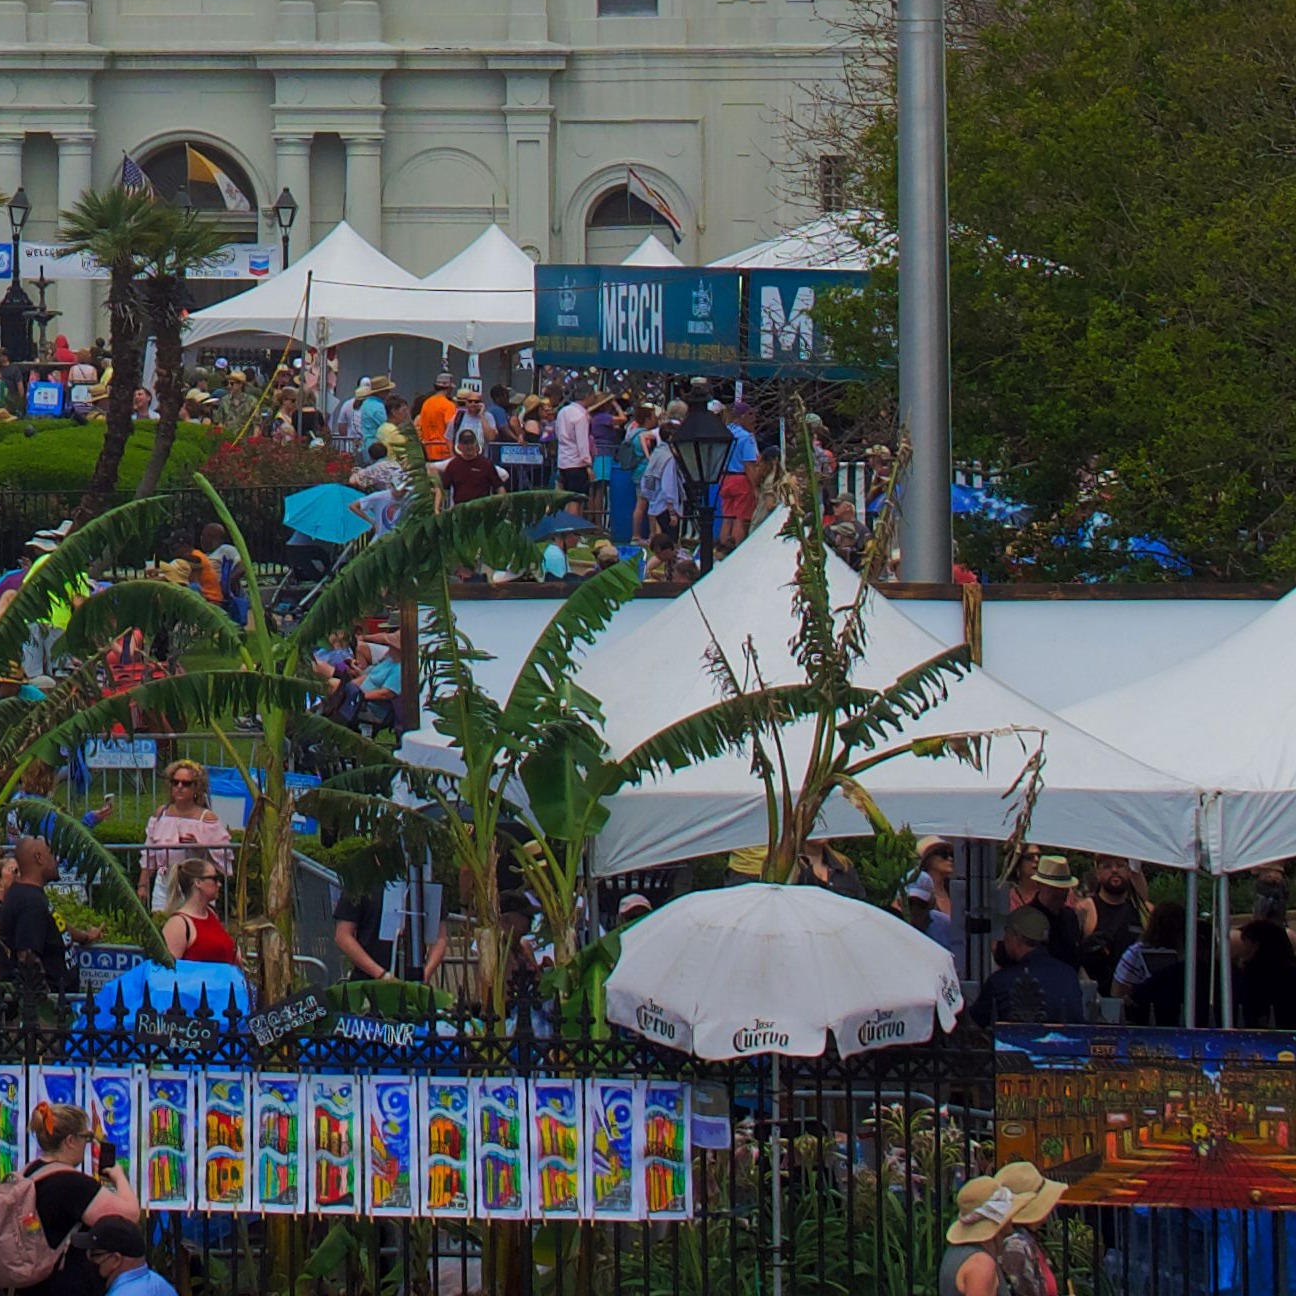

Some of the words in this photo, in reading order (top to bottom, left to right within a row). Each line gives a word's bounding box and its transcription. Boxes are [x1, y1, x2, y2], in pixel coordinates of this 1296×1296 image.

[25, 248, 60, 258] WELCO
[602, 282, 664, 355] MERCH
[733, 1027, 789, 1053] Cuervo
[857, 1018, 905, 1047] Cuervo
